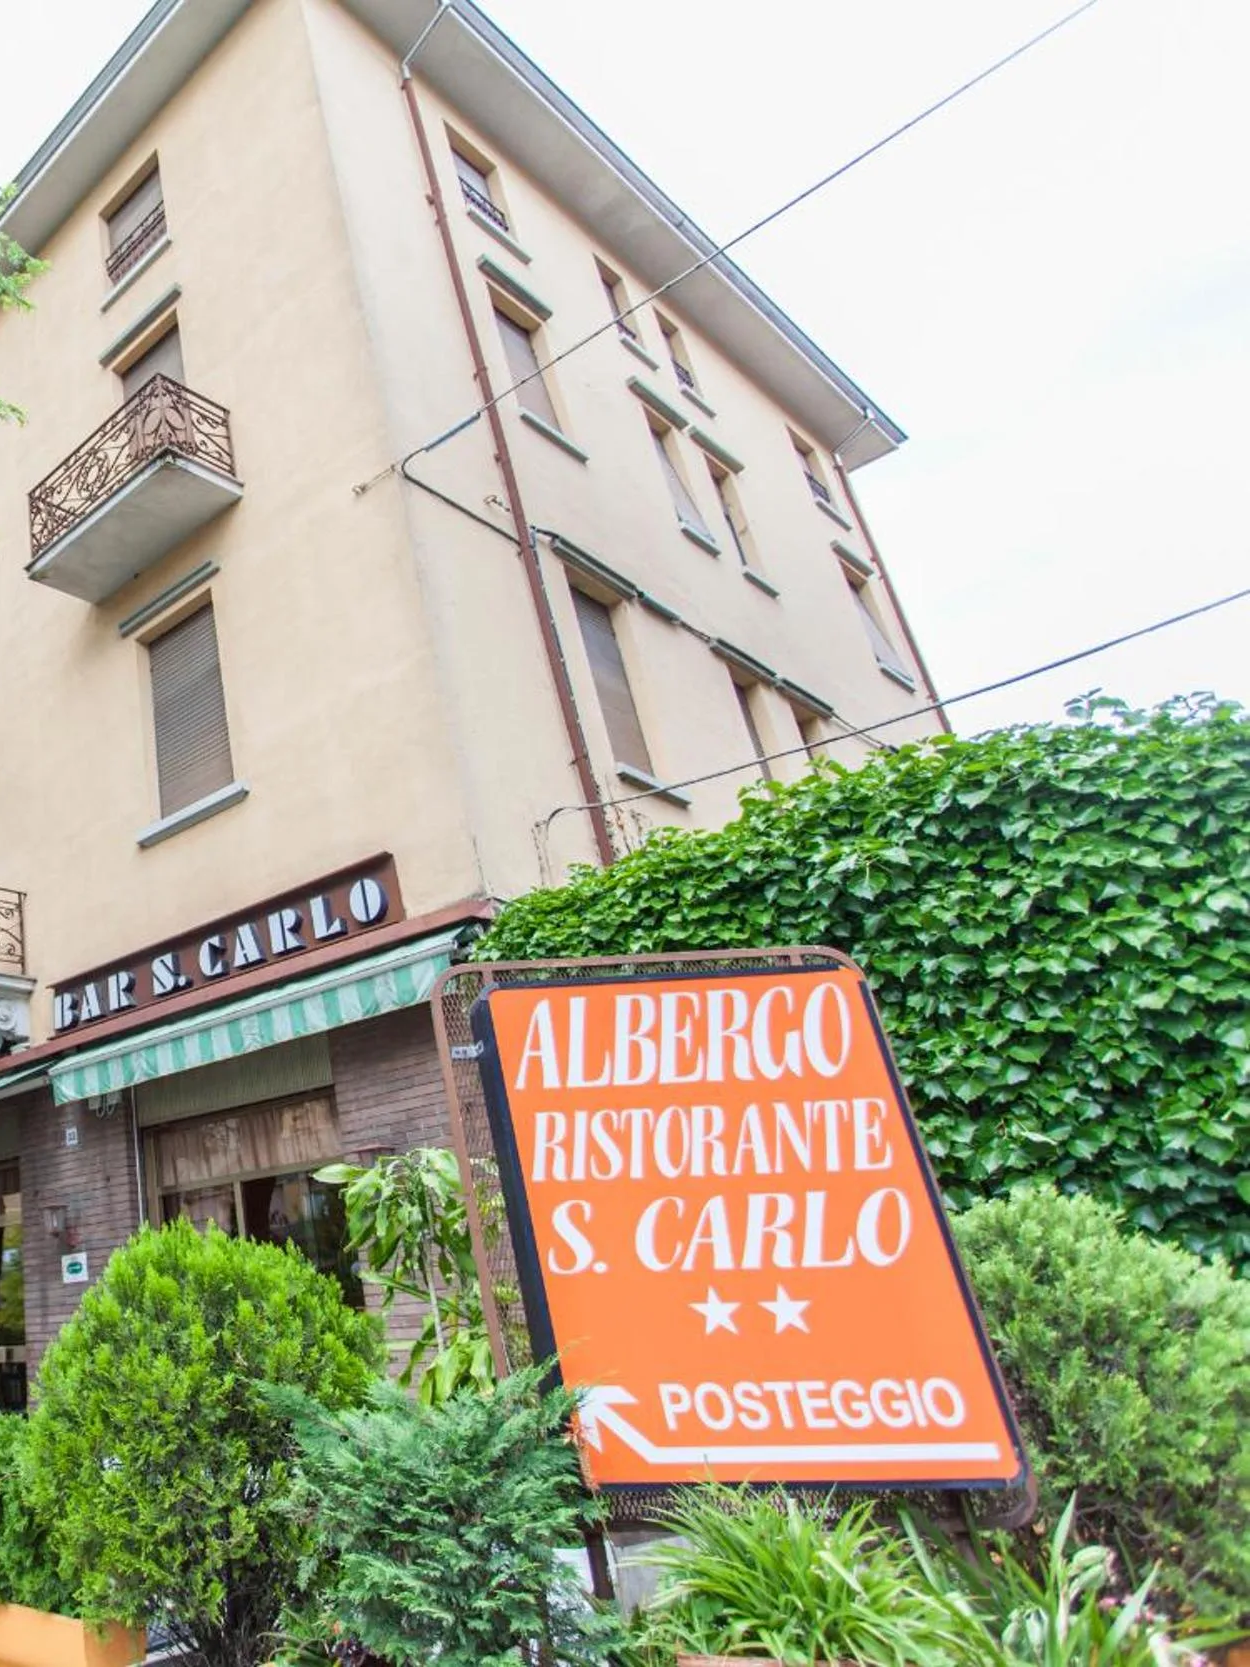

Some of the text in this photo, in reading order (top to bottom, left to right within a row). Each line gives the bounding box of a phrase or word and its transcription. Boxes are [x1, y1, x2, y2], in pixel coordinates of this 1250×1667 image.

[53, 877, 389, 1031] BAR S. CARLO
[515, 982, 852, 1090] ALBERGO
[531, 1097, 894, 1182] RISTORANTE
[547, 1187, 912, 1275] S. CARLO
[658, 1377, 966, 1431] POSTEGGIO
